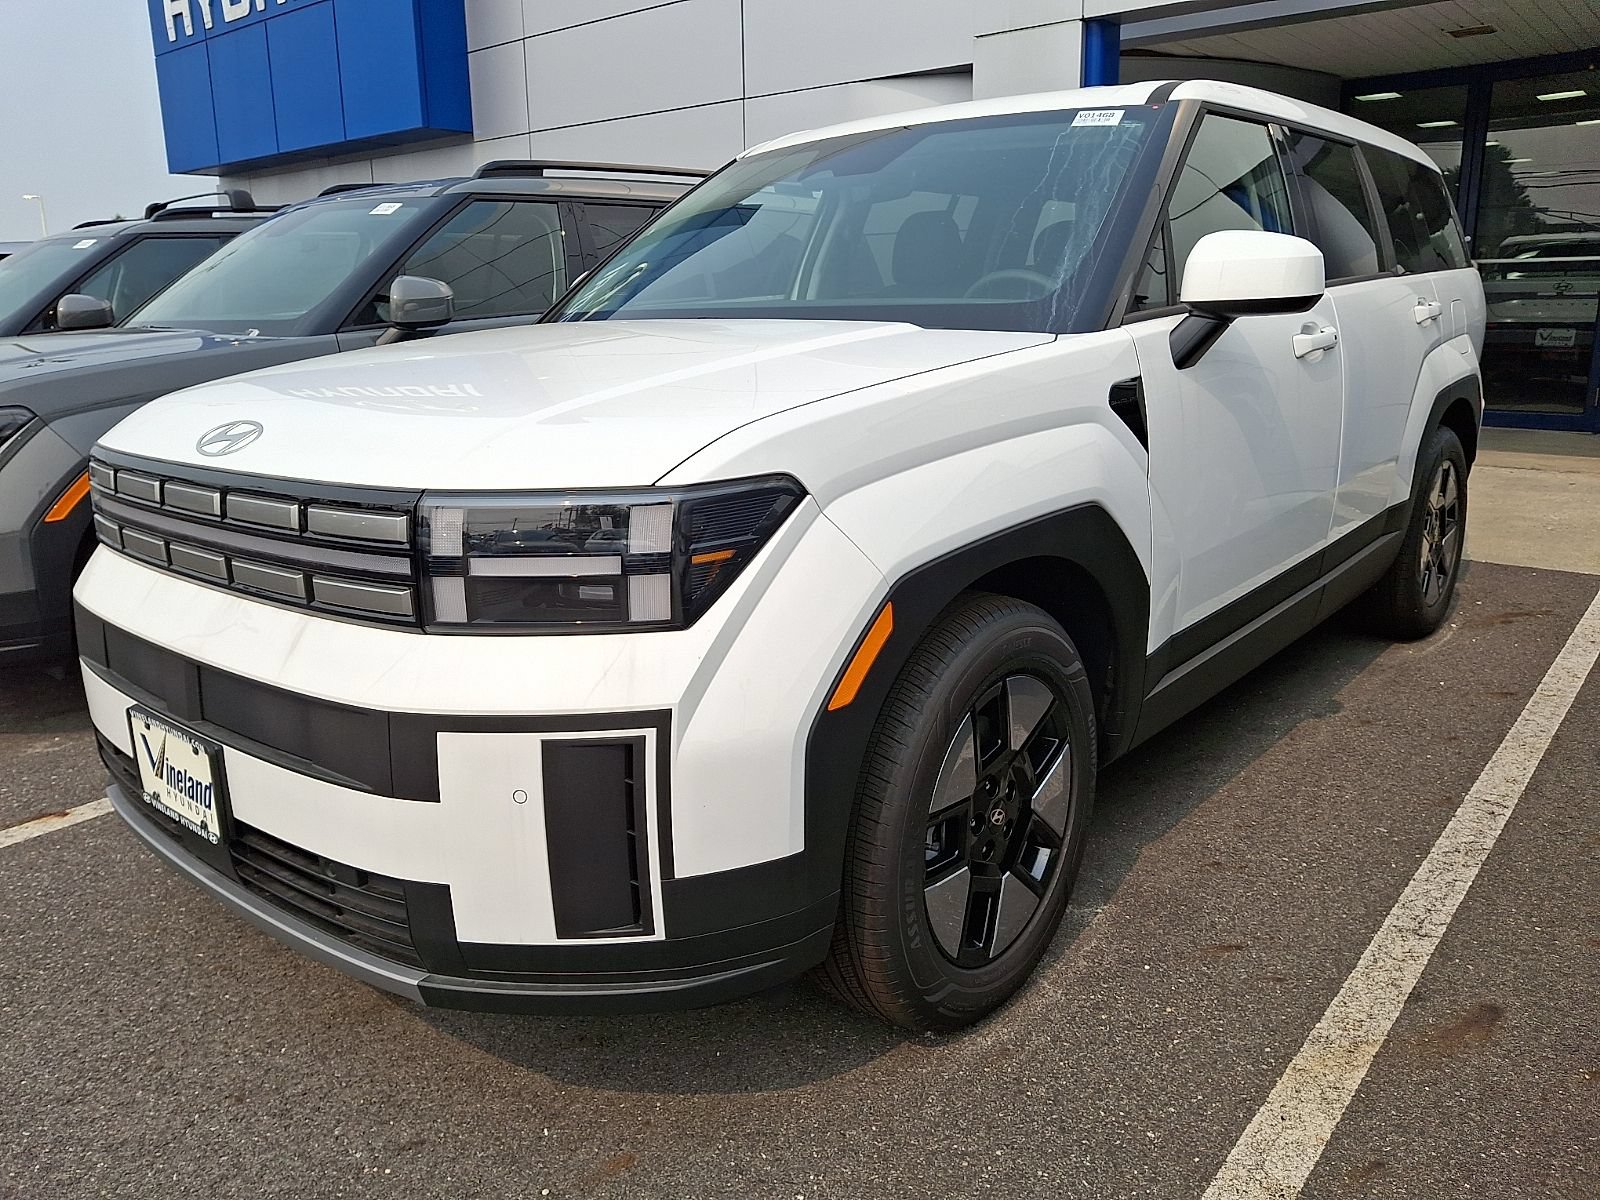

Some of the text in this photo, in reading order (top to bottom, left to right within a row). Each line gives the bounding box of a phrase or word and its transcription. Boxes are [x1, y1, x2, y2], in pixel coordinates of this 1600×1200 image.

[140, 730, 213, 811] Vineland
[151, 797, 209, 840] VINELAND HYUNDAI
[166, 788, 215, 824] HYUNDAI
